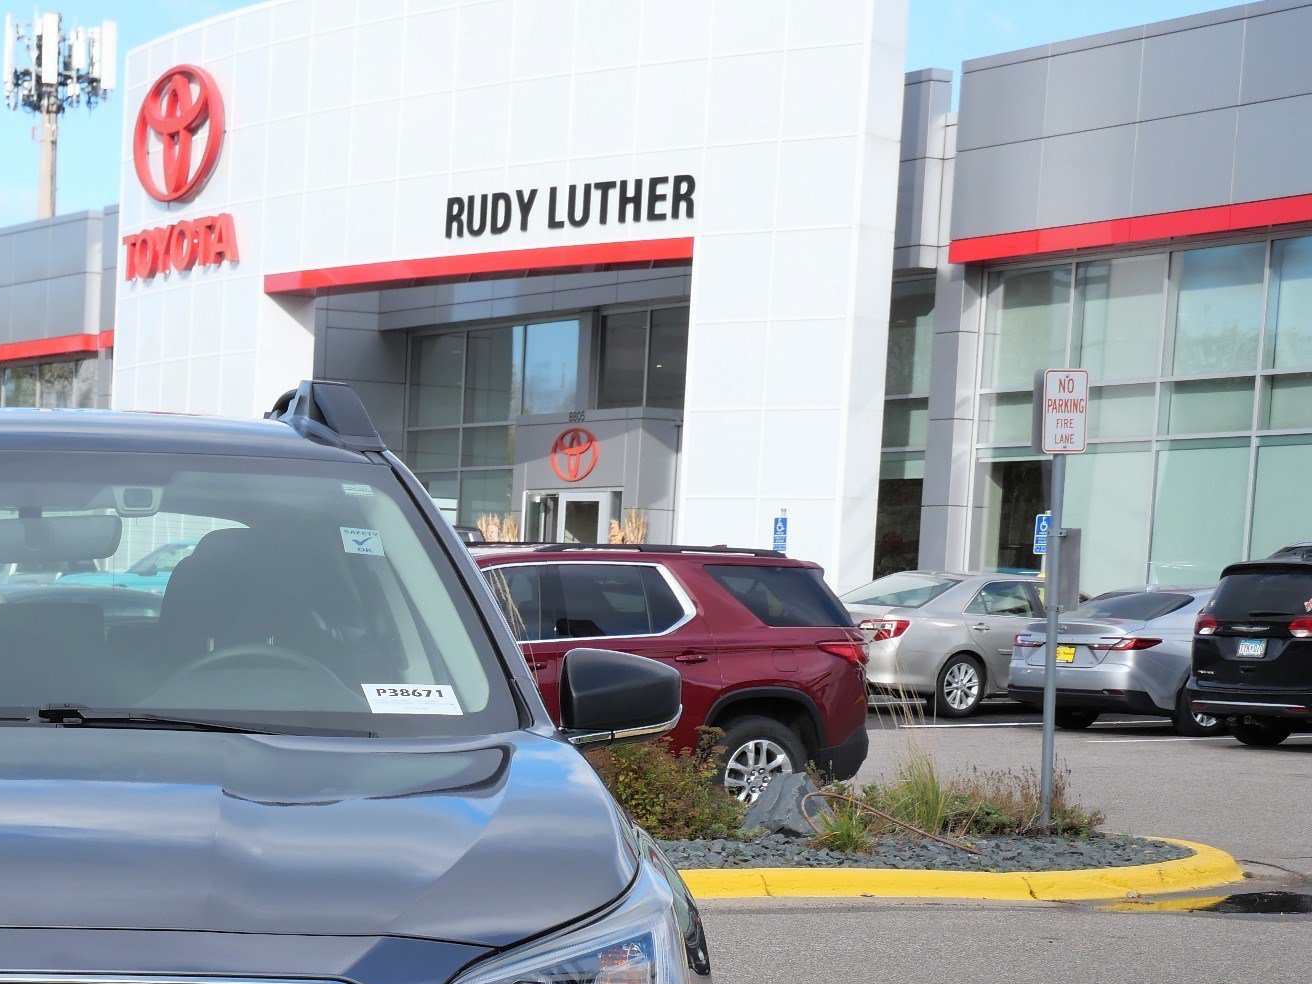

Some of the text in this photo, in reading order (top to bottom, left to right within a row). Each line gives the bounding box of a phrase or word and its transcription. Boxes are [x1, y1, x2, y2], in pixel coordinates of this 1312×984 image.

[445, 174, 696, 239] RUDY LUTHER
[122, 213, 239, 282] TOYOTA
[1058, 378, 1075, 394] NO
[1047, 398, 1085, 414] PARKING
[1055, 418, 1075, 429] FIRE
[1054, 433, 1075, 445] LANE
[343, 529, 379, 537] SAFETY
[375, 688, 444, 698] P38671
